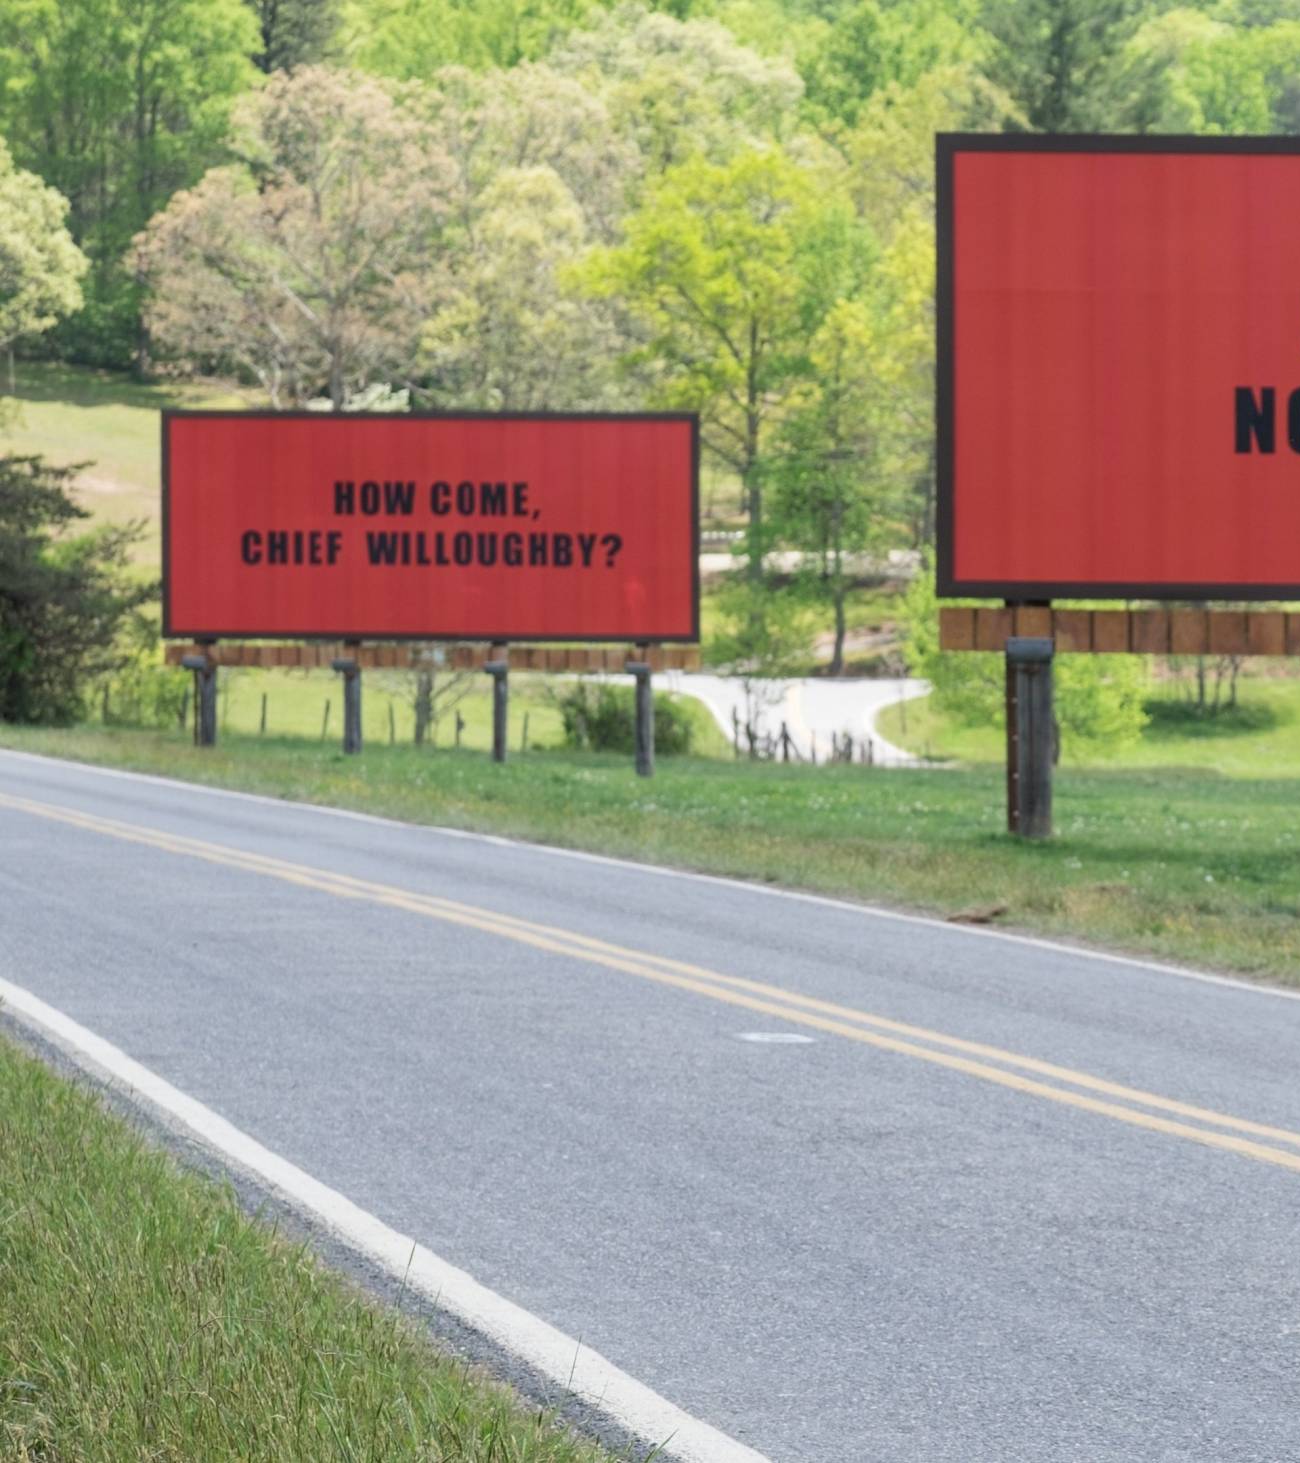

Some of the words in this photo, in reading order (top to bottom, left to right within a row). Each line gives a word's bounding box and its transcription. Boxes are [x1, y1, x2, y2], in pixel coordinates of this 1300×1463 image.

[334, 480, 416, 517] HOW
[429, 480, 542, 521] COME,
[241, 530, 343, 567] CHIEF
[366, 531, 624, 569] WILLOUGHBY?
